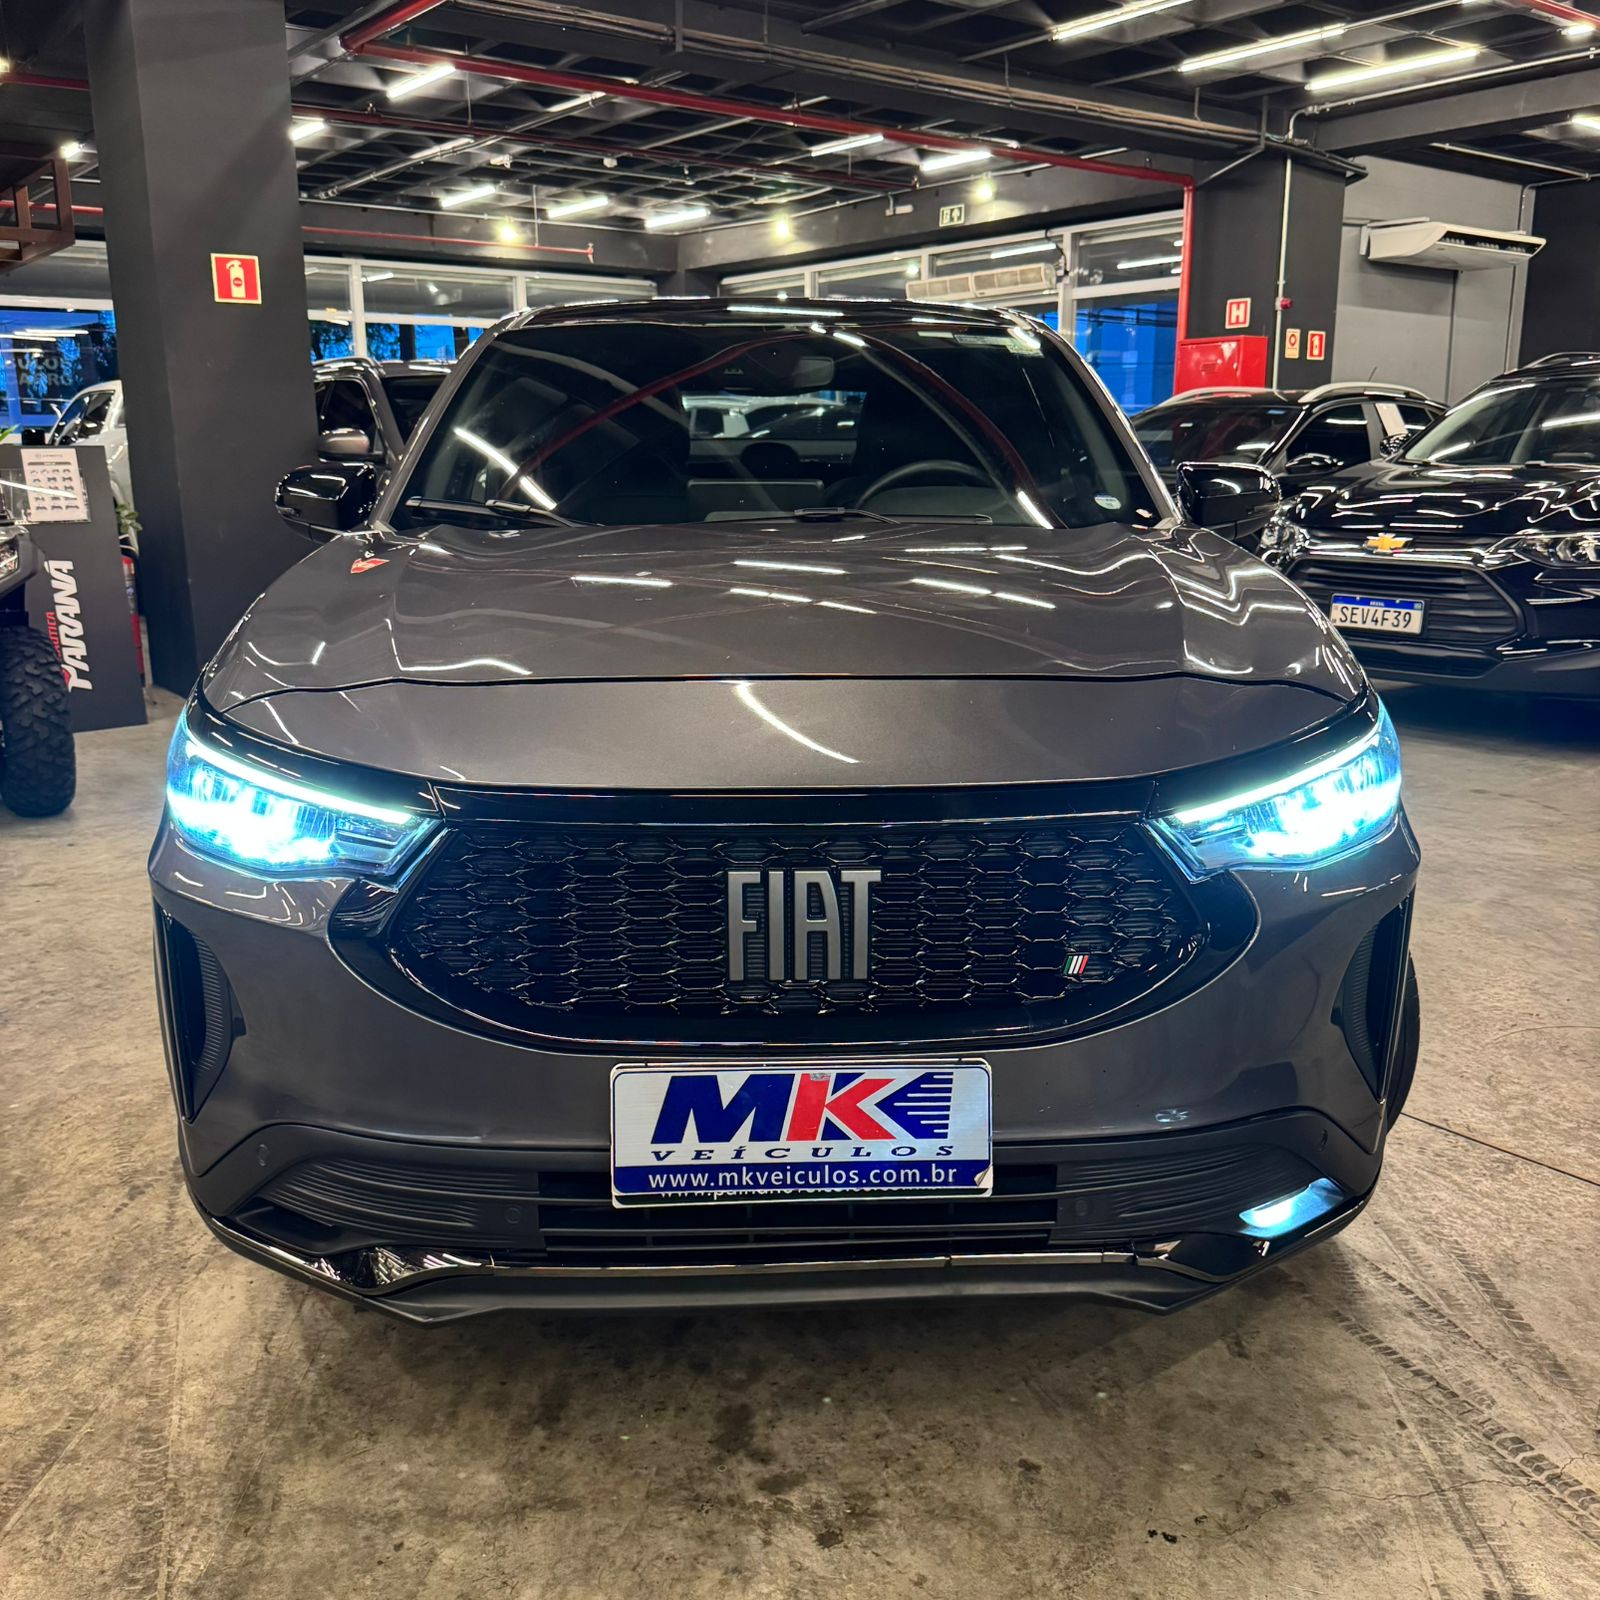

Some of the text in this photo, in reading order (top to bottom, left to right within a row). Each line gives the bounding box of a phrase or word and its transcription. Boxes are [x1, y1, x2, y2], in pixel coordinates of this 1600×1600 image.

[1230, 303, 1247, 324] H
[1339, 605, 1412, 629] SEV4F39
[727, 869, 882, 982] FIAT
[651, 1071, 898, 1145] MK
[650, 1144, 955, 1162] VEÍCULOS
[648, 1163, 957, 1189] www.mkveiculos.com.br
